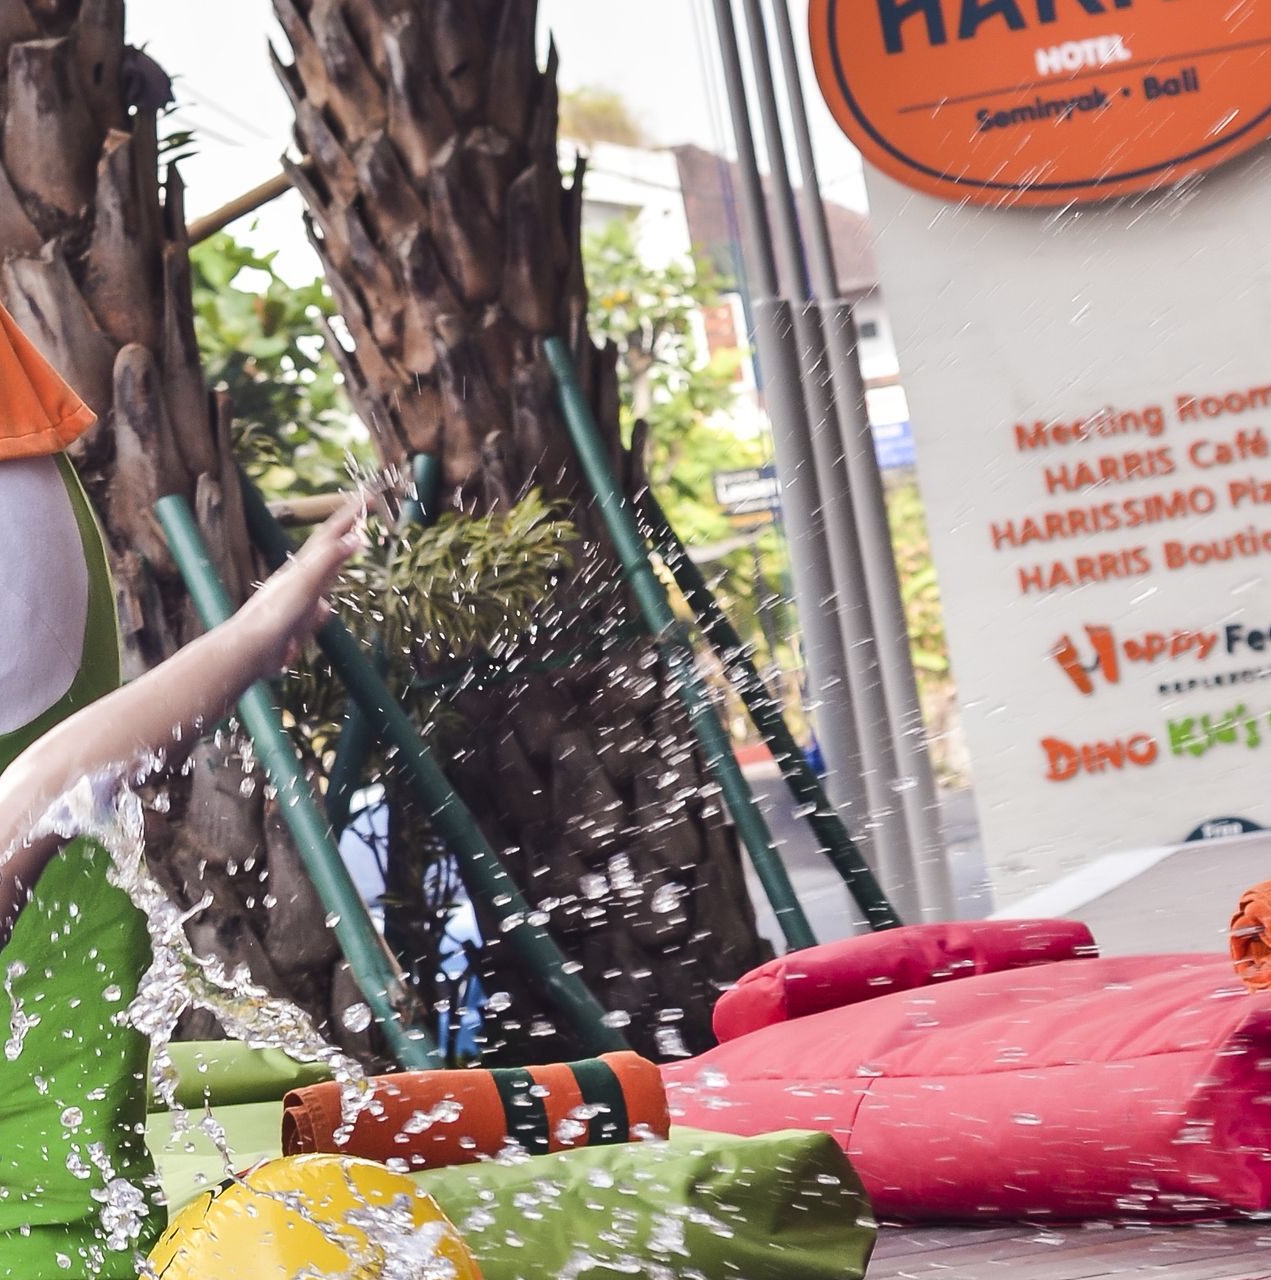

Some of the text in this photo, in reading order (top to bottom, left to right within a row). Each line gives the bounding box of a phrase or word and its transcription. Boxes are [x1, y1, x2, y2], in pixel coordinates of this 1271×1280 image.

[1034, 34, 1132, 76] HOTEL
[976, 67, 1199, 132] Seminyak Bali
[1014, 405, 1164, 452] Meeting
[1044, 428, 1268, 495] HARRIS Café
[990, 485, 1215, 550] HARRISSIMO
[1018, 546, 1150, 594] HARRIS
